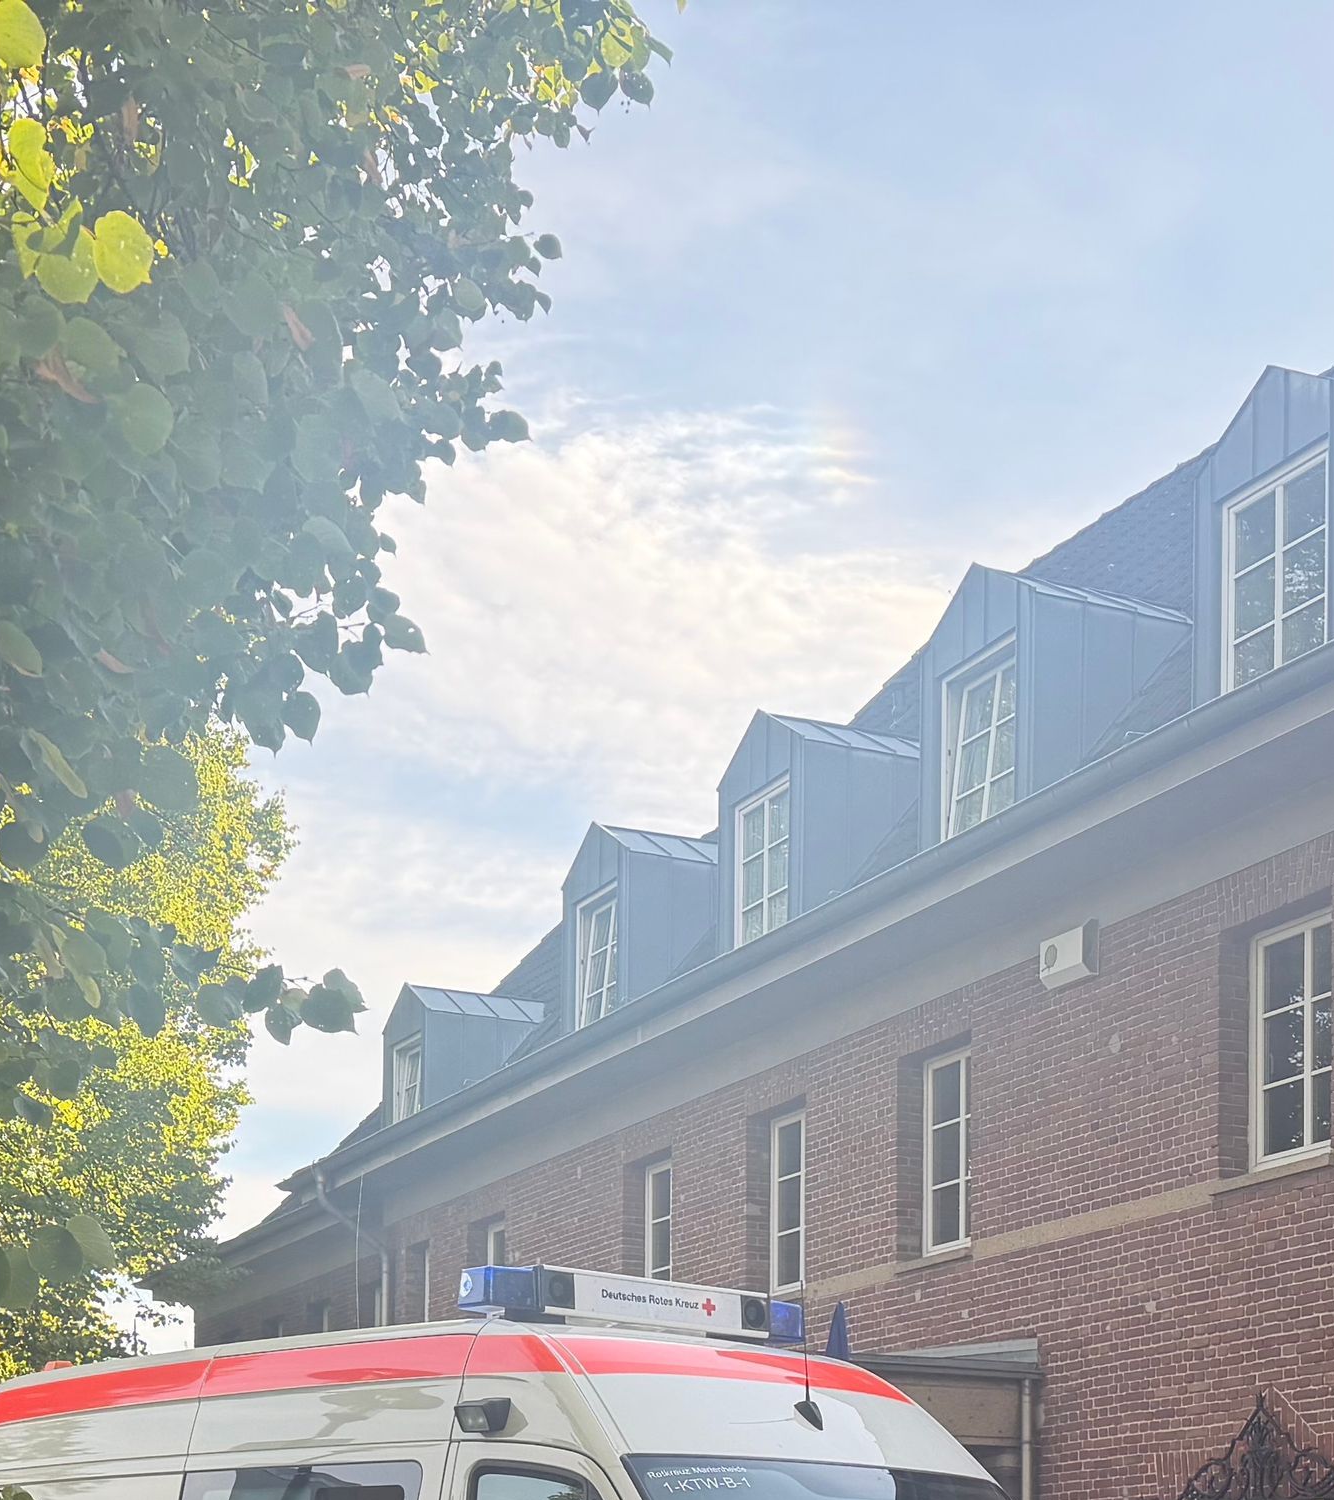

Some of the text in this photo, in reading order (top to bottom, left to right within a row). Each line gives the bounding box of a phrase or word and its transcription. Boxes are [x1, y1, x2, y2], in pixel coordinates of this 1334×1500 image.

[601, 1288, 700, 1310] Deutsches Rotes Kreuz
[646, 1467, 692, 1479] Rotkreuz
[663, 1476, 752, 1494] 1-KTW-B-1
